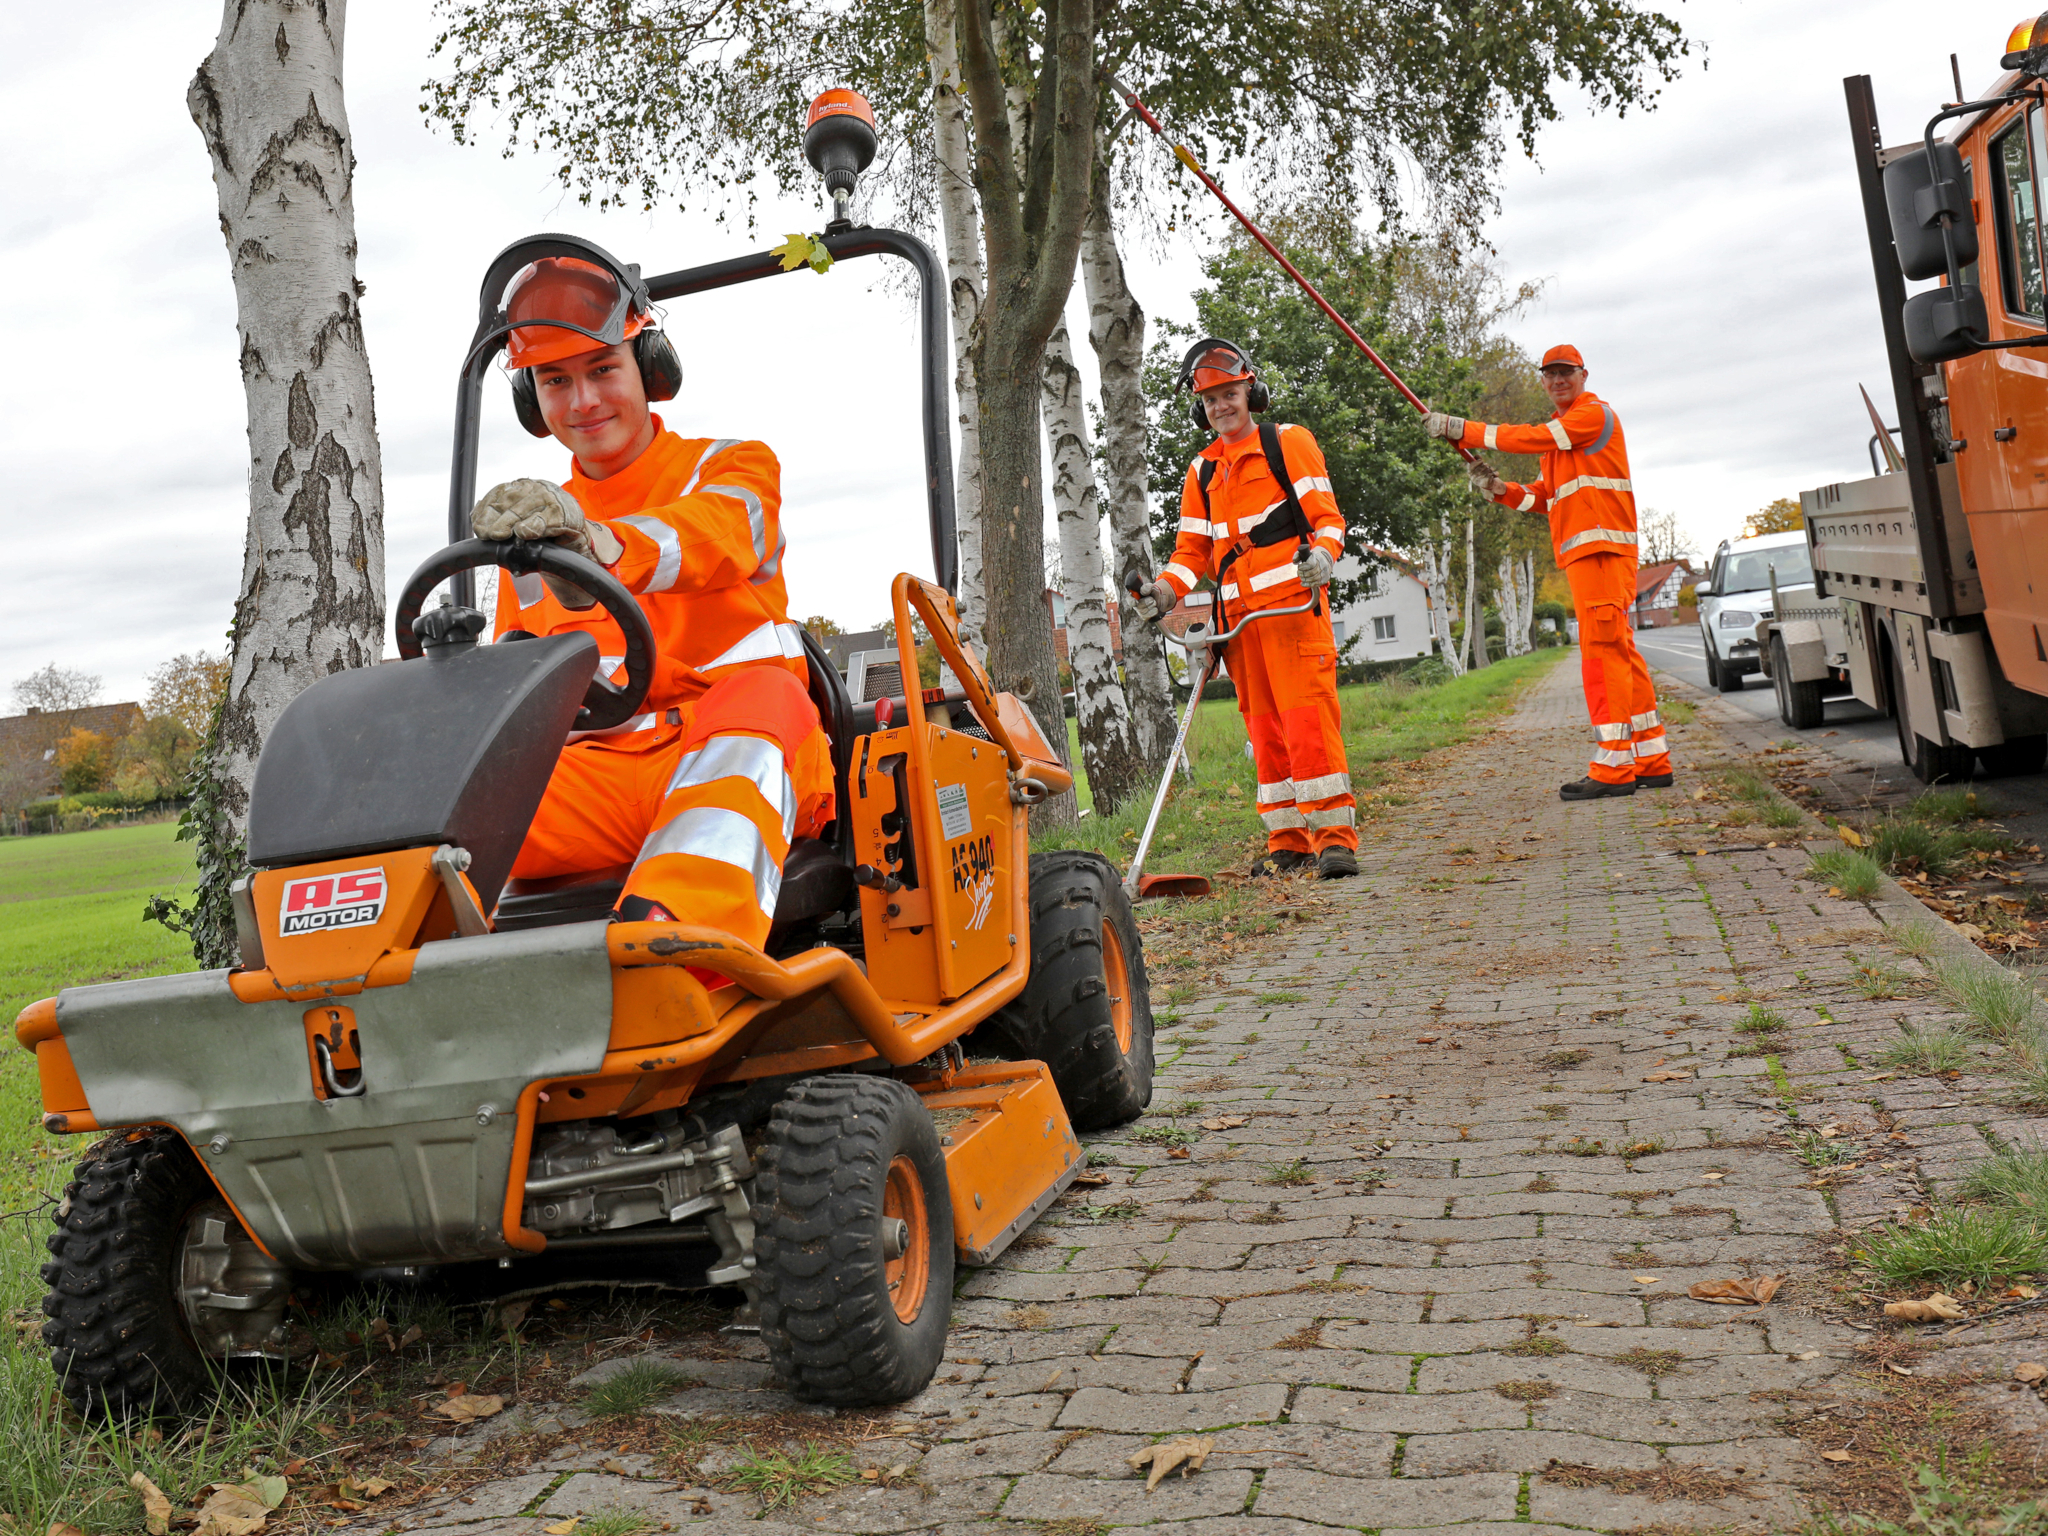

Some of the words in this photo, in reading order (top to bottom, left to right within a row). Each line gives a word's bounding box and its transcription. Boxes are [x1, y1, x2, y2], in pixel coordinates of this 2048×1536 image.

[872, 828, 879, 837] 5
[875, 857, 882, 866] 4
[287, 871, 383, 912] AS
[289, 906, 374, 931] MOTOR
[881, 913, 888, 923] 2
